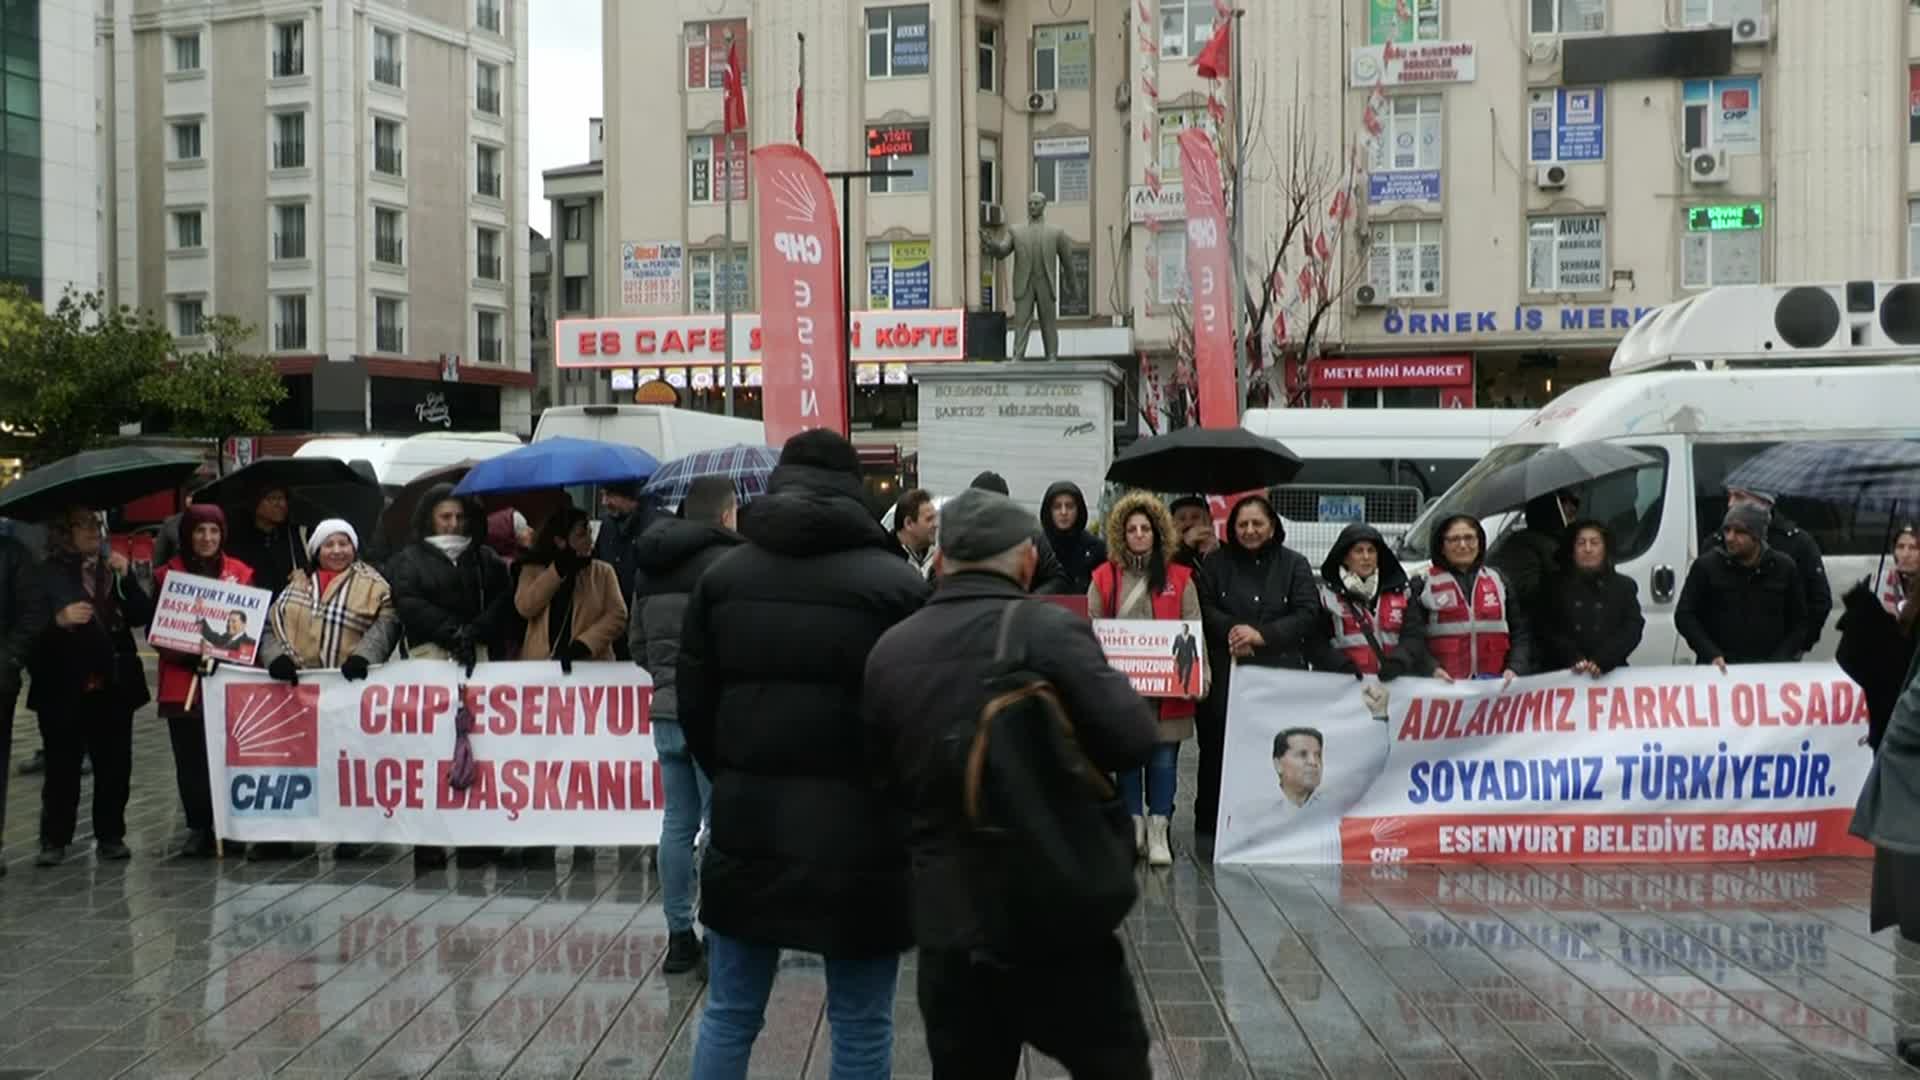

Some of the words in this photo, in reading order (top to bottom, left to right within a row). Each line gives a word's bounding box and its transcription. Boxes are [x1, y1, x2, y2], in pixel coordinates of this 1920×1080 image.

[1723, 111, 1747, 120] CHP
[1560, 218, 1600, 235] AVUKAT
[896, 247, 927, 257] ESEN
[1384, 305, 1497, 333] ÖRNEK
[578, 331, 621, 355] ES
[636, 327, 726, 353] CAFE
[876, 322, 958, 348] KÖFTE
[1323, 367, 1364, 379] METE
[1367, 364, 1399, 378] MİNİ
[1402, 364, 1464, 377] MARKET
[168, 582, 225, 602] ESENYURT
[226, 592, 261, 609] HALKI
[361, 685, 449, 735] CHP
[1398, 687, 1577, 741] ADLARIMIZ
[1587, 684, 1721, 732] FARKLI
[337, 749, 425, 818] İLÇE
[1407, 757, 1604, 805] SOYADIMIZ
[1615, 739, 1836, 800] TÜRKİYEDİR.
[230, 773, 312, 811] CHP
[1438, 824, 1577, 854] ESENYURT
[1583, 816, 1706, 853] BELEDİYE
[1712, 821, 1818, 857] BAŞKANI
[1370, 847, 1408, 863] CHP
